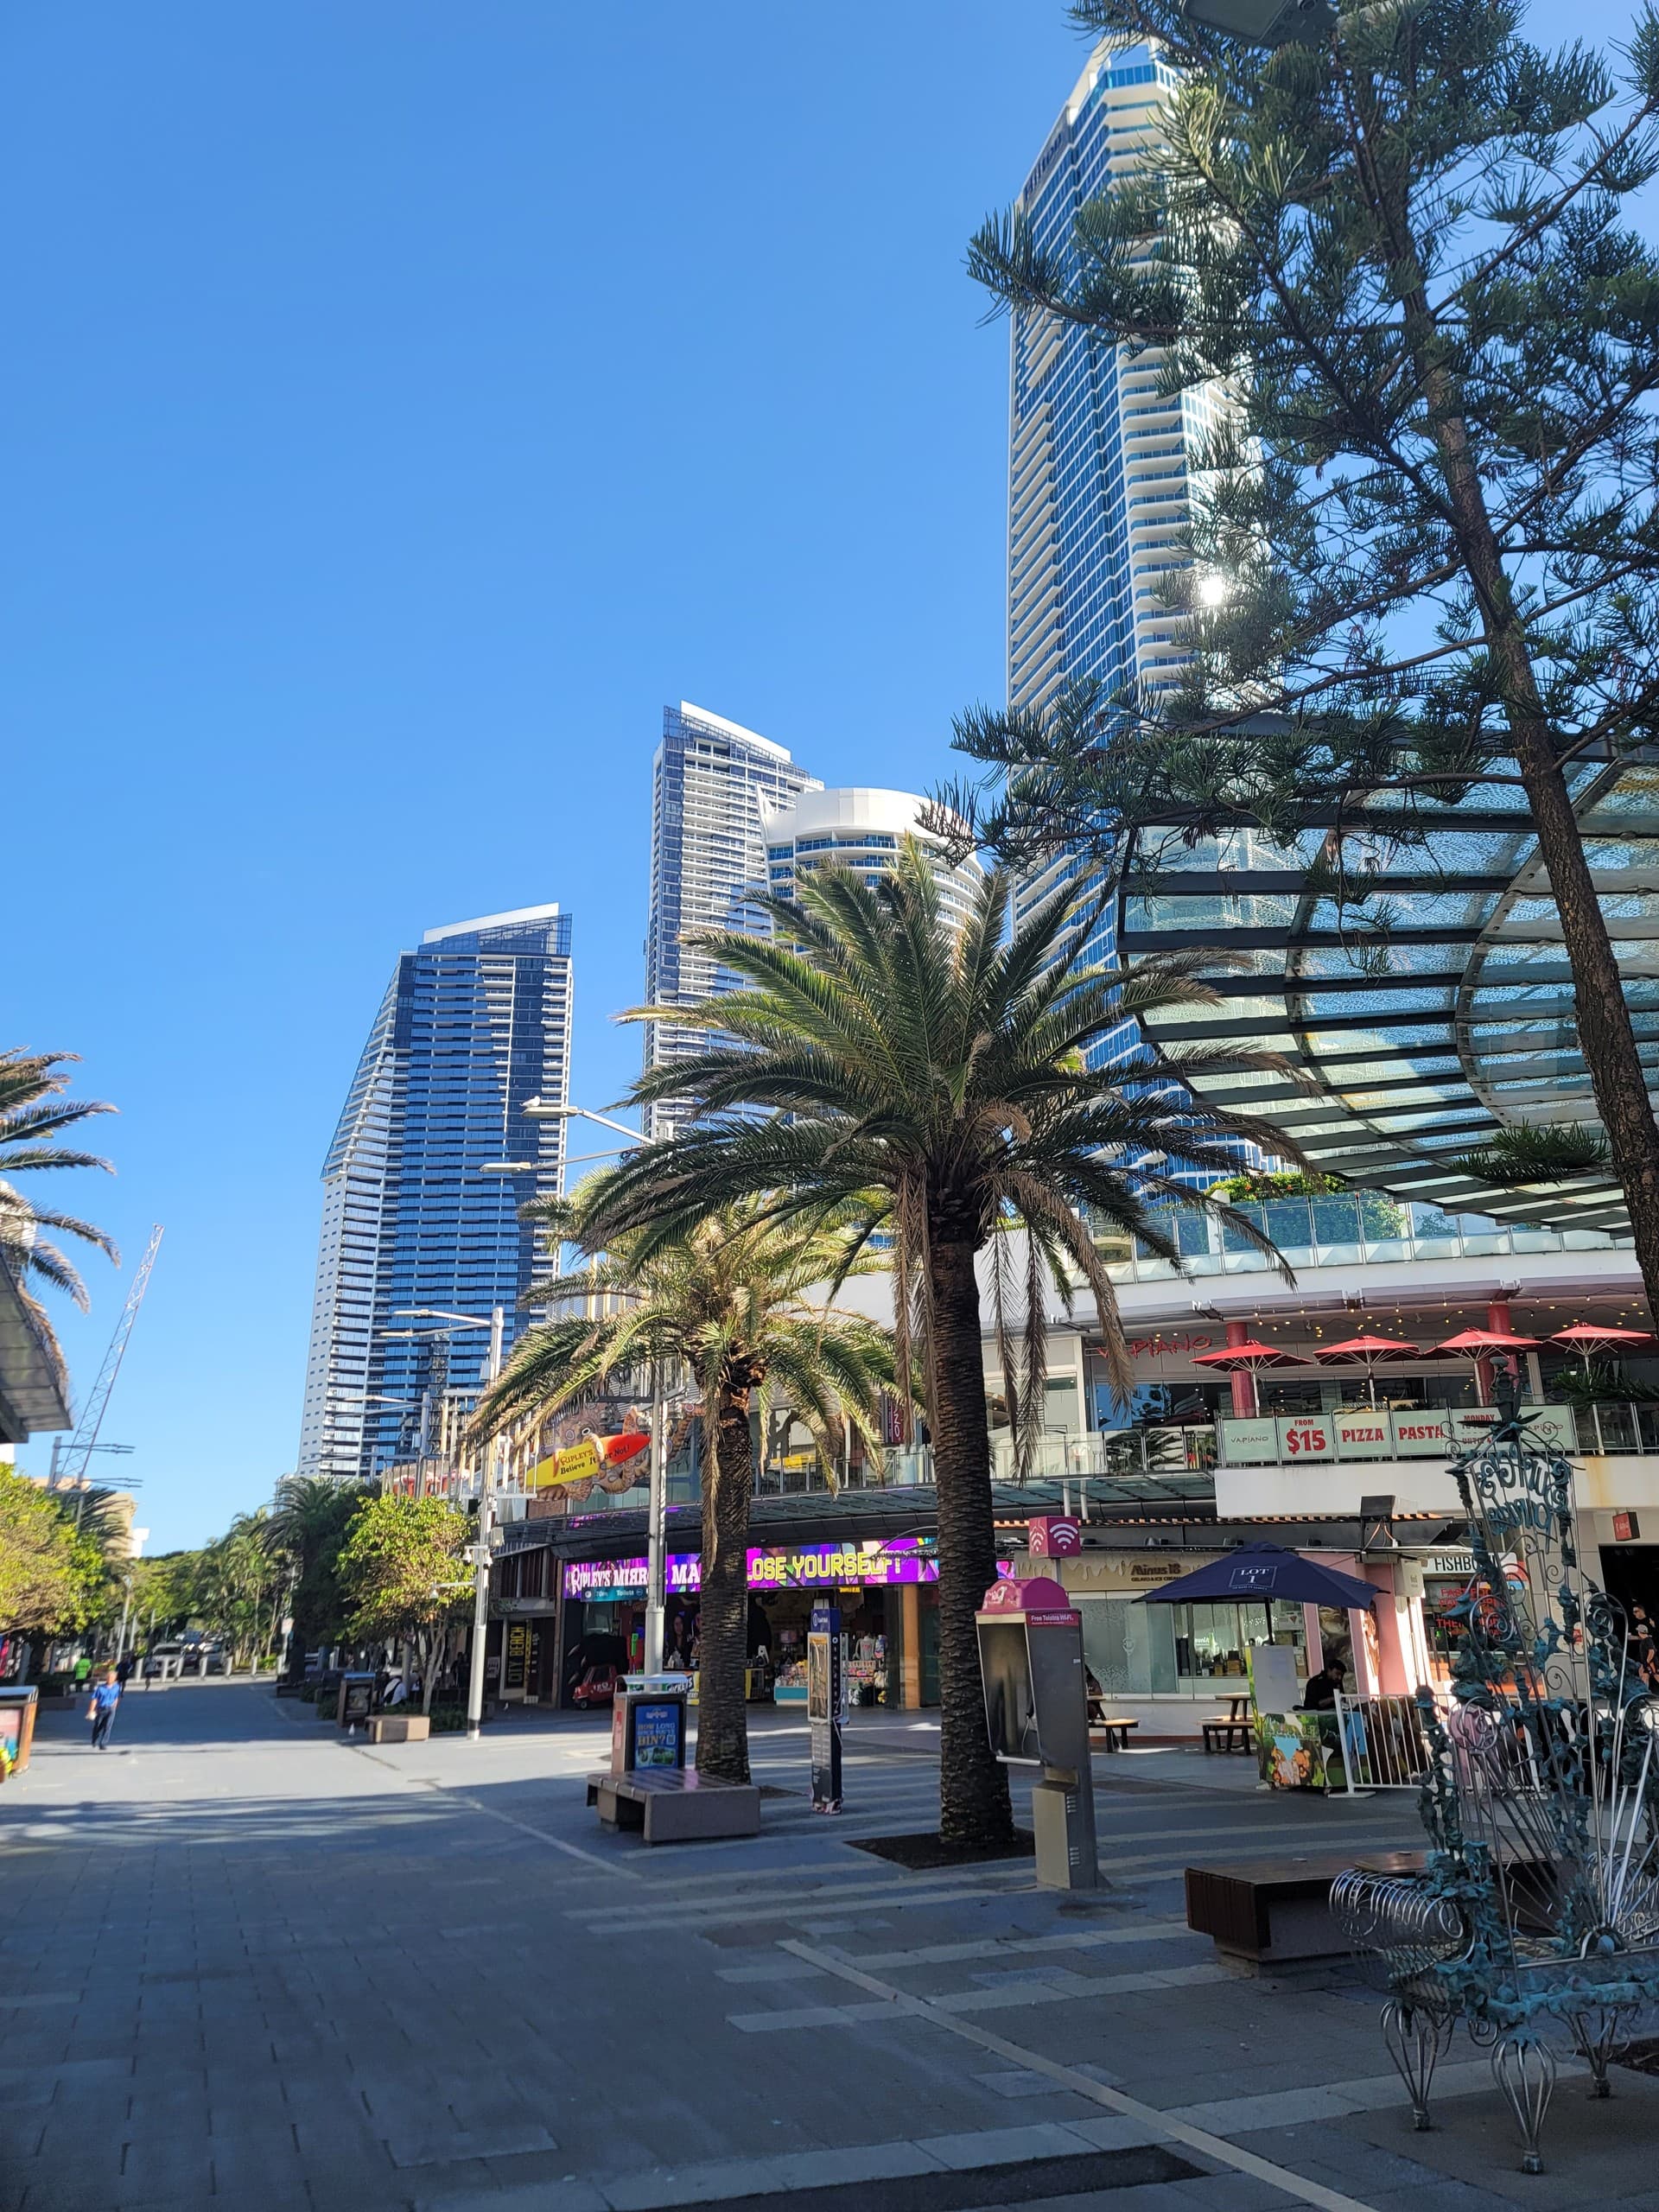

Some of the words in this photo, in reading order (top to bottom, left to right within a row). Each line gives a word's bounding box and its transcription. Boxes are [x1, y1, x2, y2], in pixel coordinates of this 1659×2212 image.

[1096, 1333, 1212, 1359] VPIANO
[1231, 1435, 1269, 1444] VAPIANO
[1286, 1428, 1326, 1454] $15
[1342, 1428, 1384, 1443] PIZZA
[1398, 1425, 1445, 1440] PASTA
[560, 1461, 585, 1475] Believe
[589, 1457, 596, 1465] It
[614, 1444, 630, 1456] Not!
[561, 1449, 594, 1465] RIPLEY'S
[791, 1553, 901, 1579] YOURSELF!
[1434, 1555, 1497, 1571] FISHBO
[570, 1567, 611, 1596] RIPLEY'S
[613, 1567, 668, 1586] MIRR
[671, 1562, 702, 1585] MA
